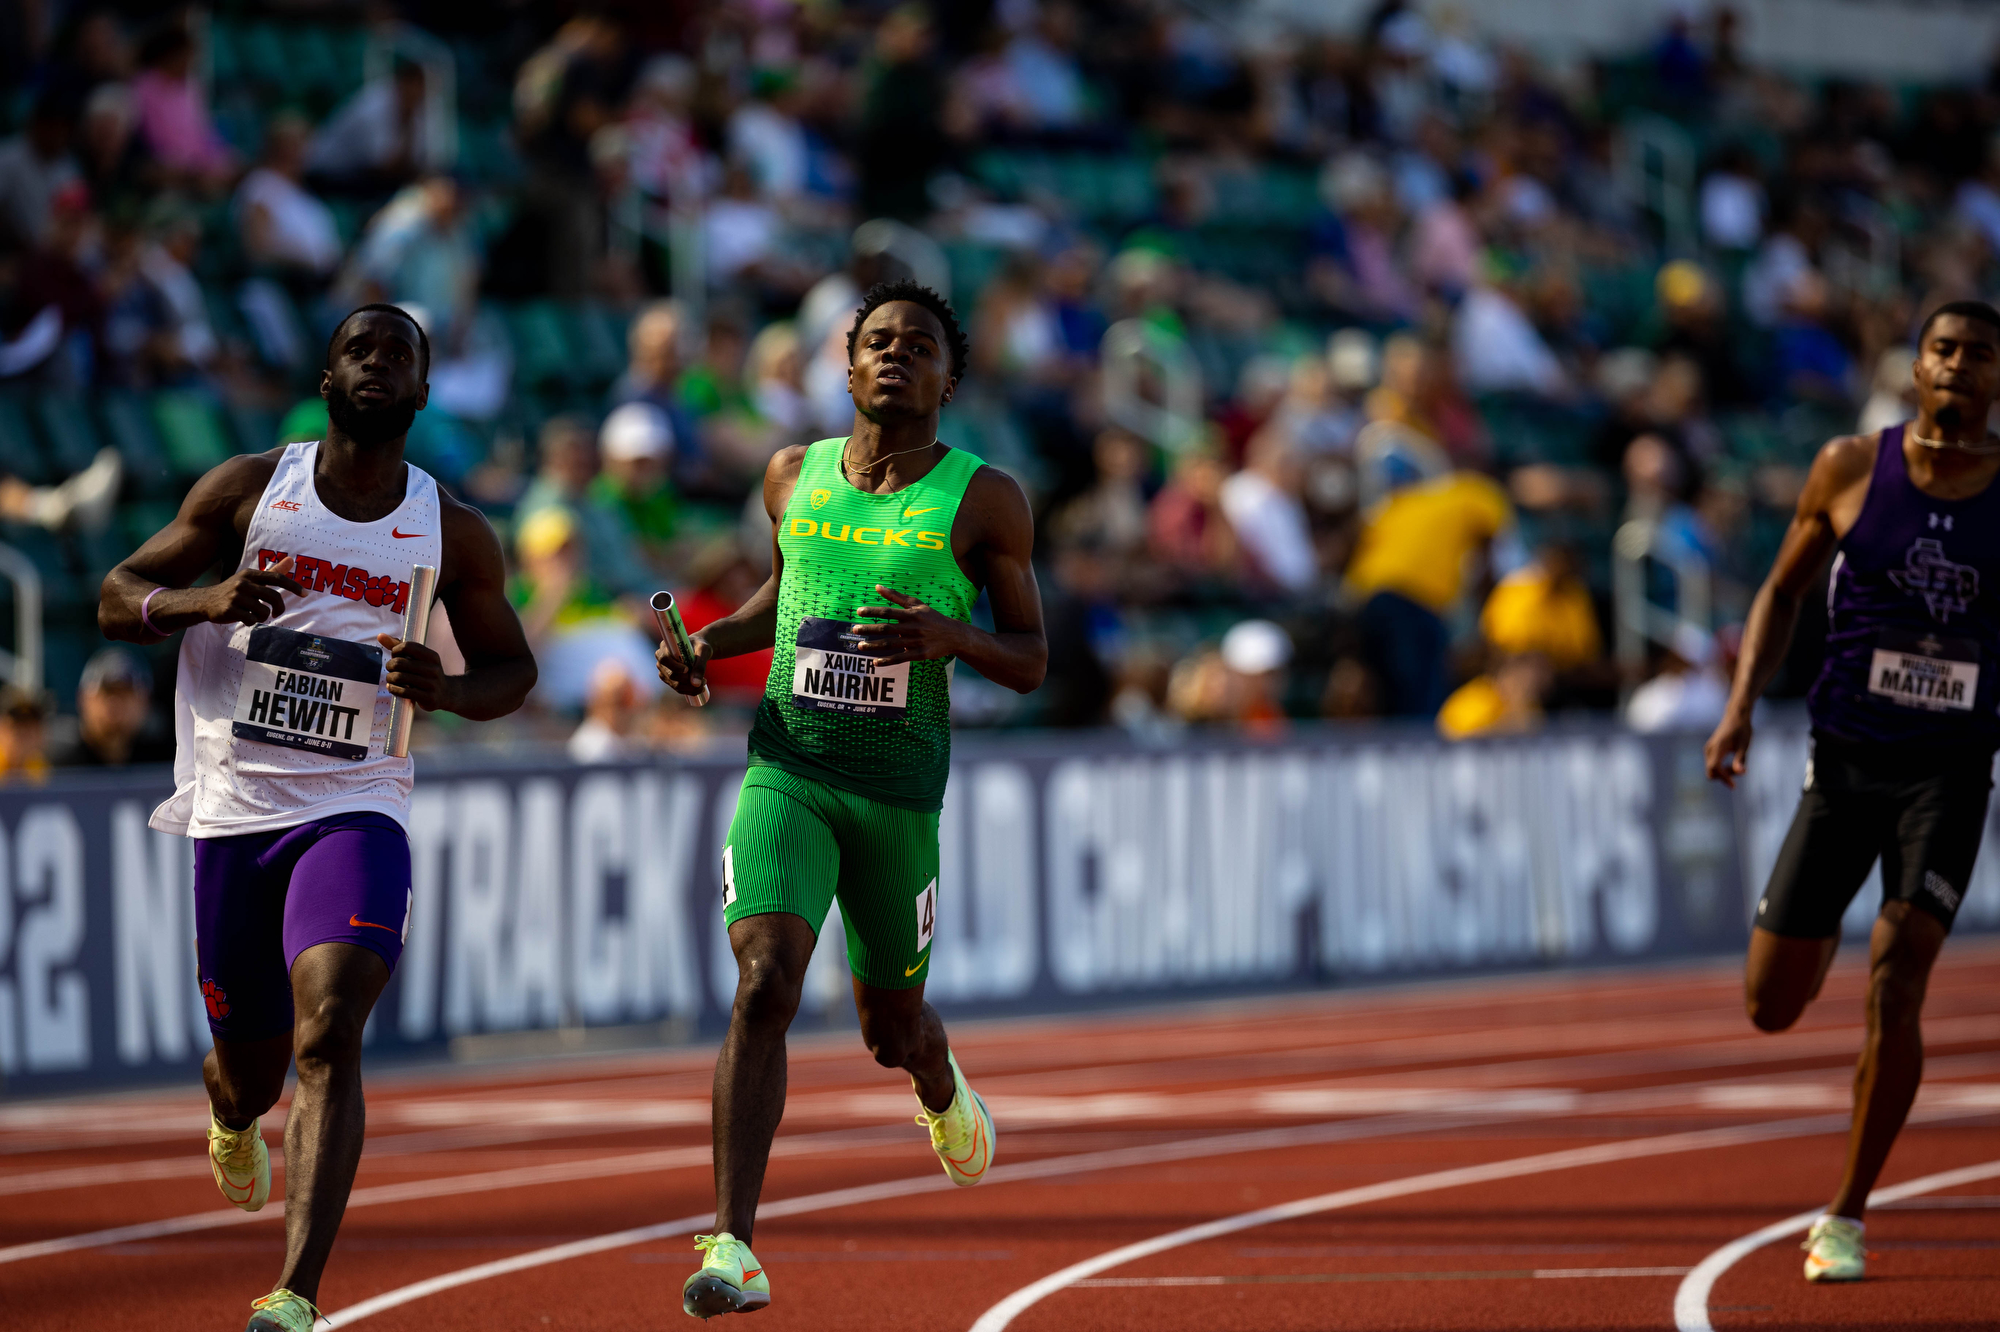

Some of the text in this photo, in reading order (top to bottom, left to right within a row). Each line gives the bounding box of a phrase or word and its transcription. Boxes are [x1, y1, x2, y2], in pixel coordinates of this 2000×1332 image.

[270, 500, 303, 512] ACC
[789, 518, 946, 550] DUCKS
[824, 653, 876, 674] XAVIER
[275, 670, 343, 702] FABIAN
[804, 667, 895, 702] NAIRNE
[1880, 669, 1964, 702] MATTAR
[248, 689, 360, 740] HEWITT
[266, 731, 285, 741] EUGENE,
[304, 738, 321, 747] JUNE
[400, 772, 698, 1040] TRACK
[1045, 742, 1657, 992] CHAMPIONSHIPS
[922, 886, 934, 939] 4
